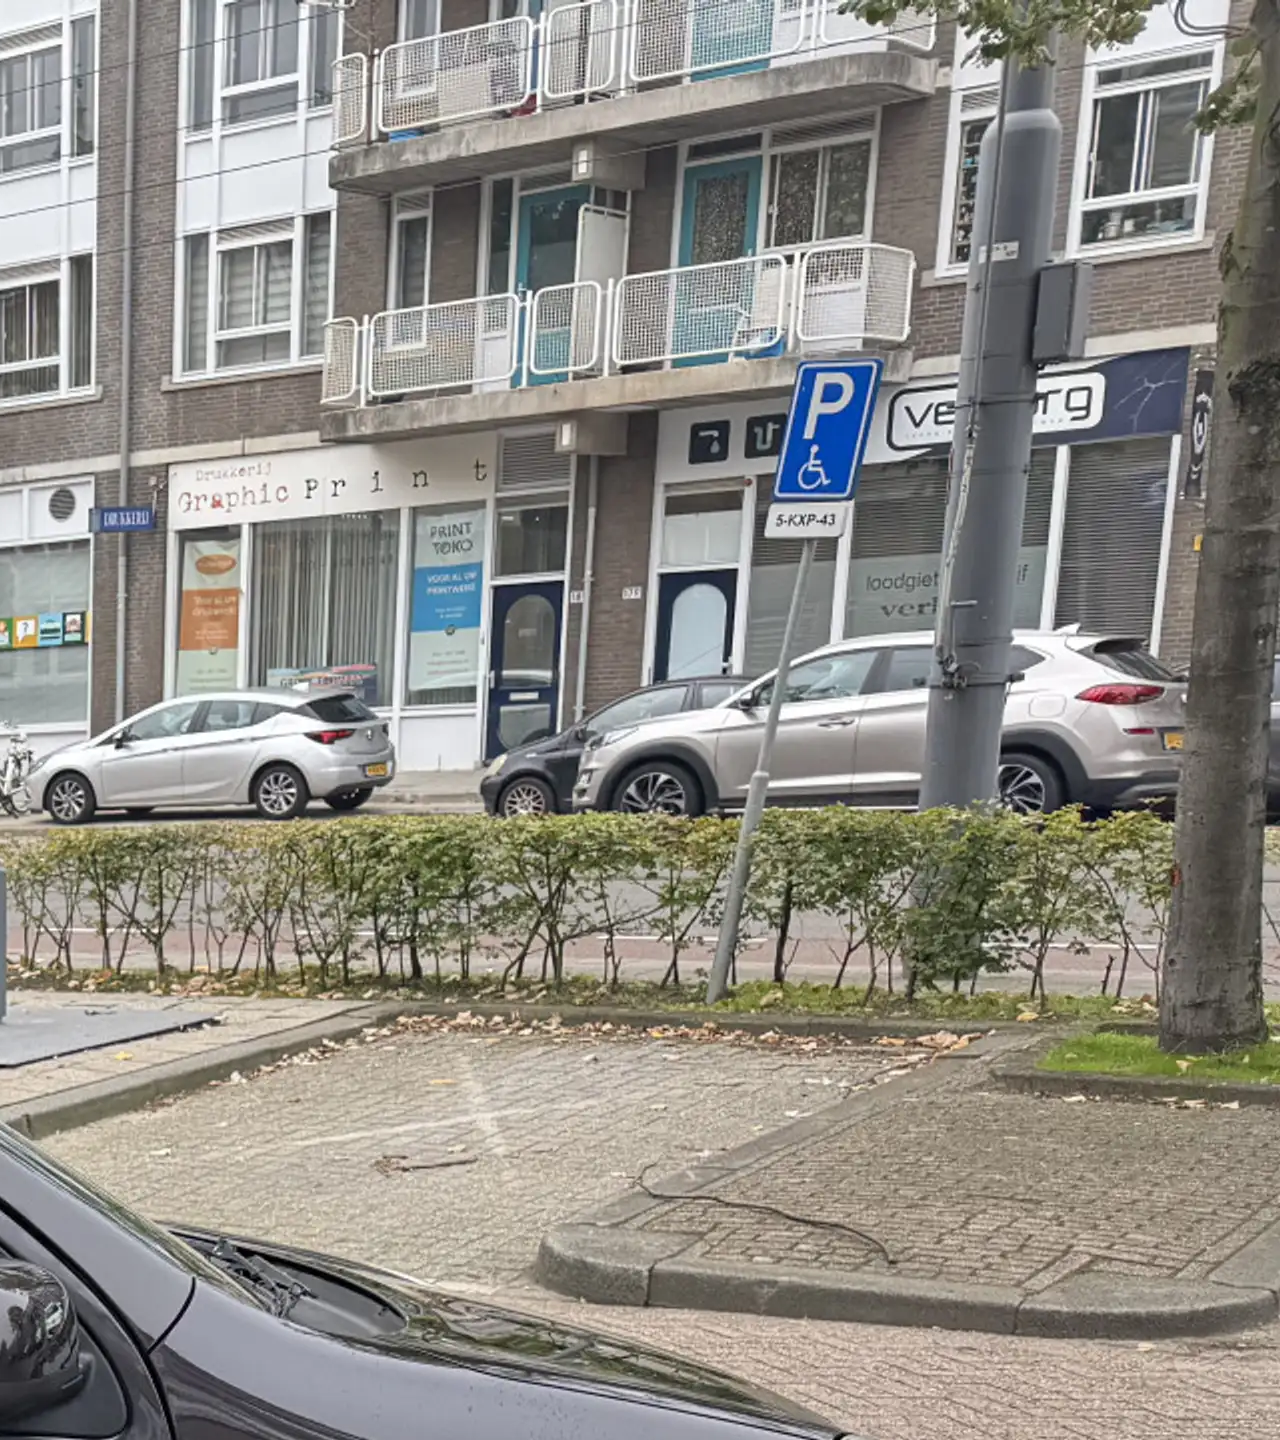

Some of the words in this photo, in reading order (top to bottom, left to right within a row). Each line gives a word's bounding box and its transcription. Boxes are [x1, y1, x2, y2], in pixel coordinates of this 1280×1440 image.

[803, 372, 855, 440] P
[195, 461, 273, 482] Drukkerij
[178, 483, 290, 514] Graphic
[775, 512, 837, 528] 5-KXP-43
[429, 521, 473, 539] PRINT
[431, 538, 474, 556] TOKO
